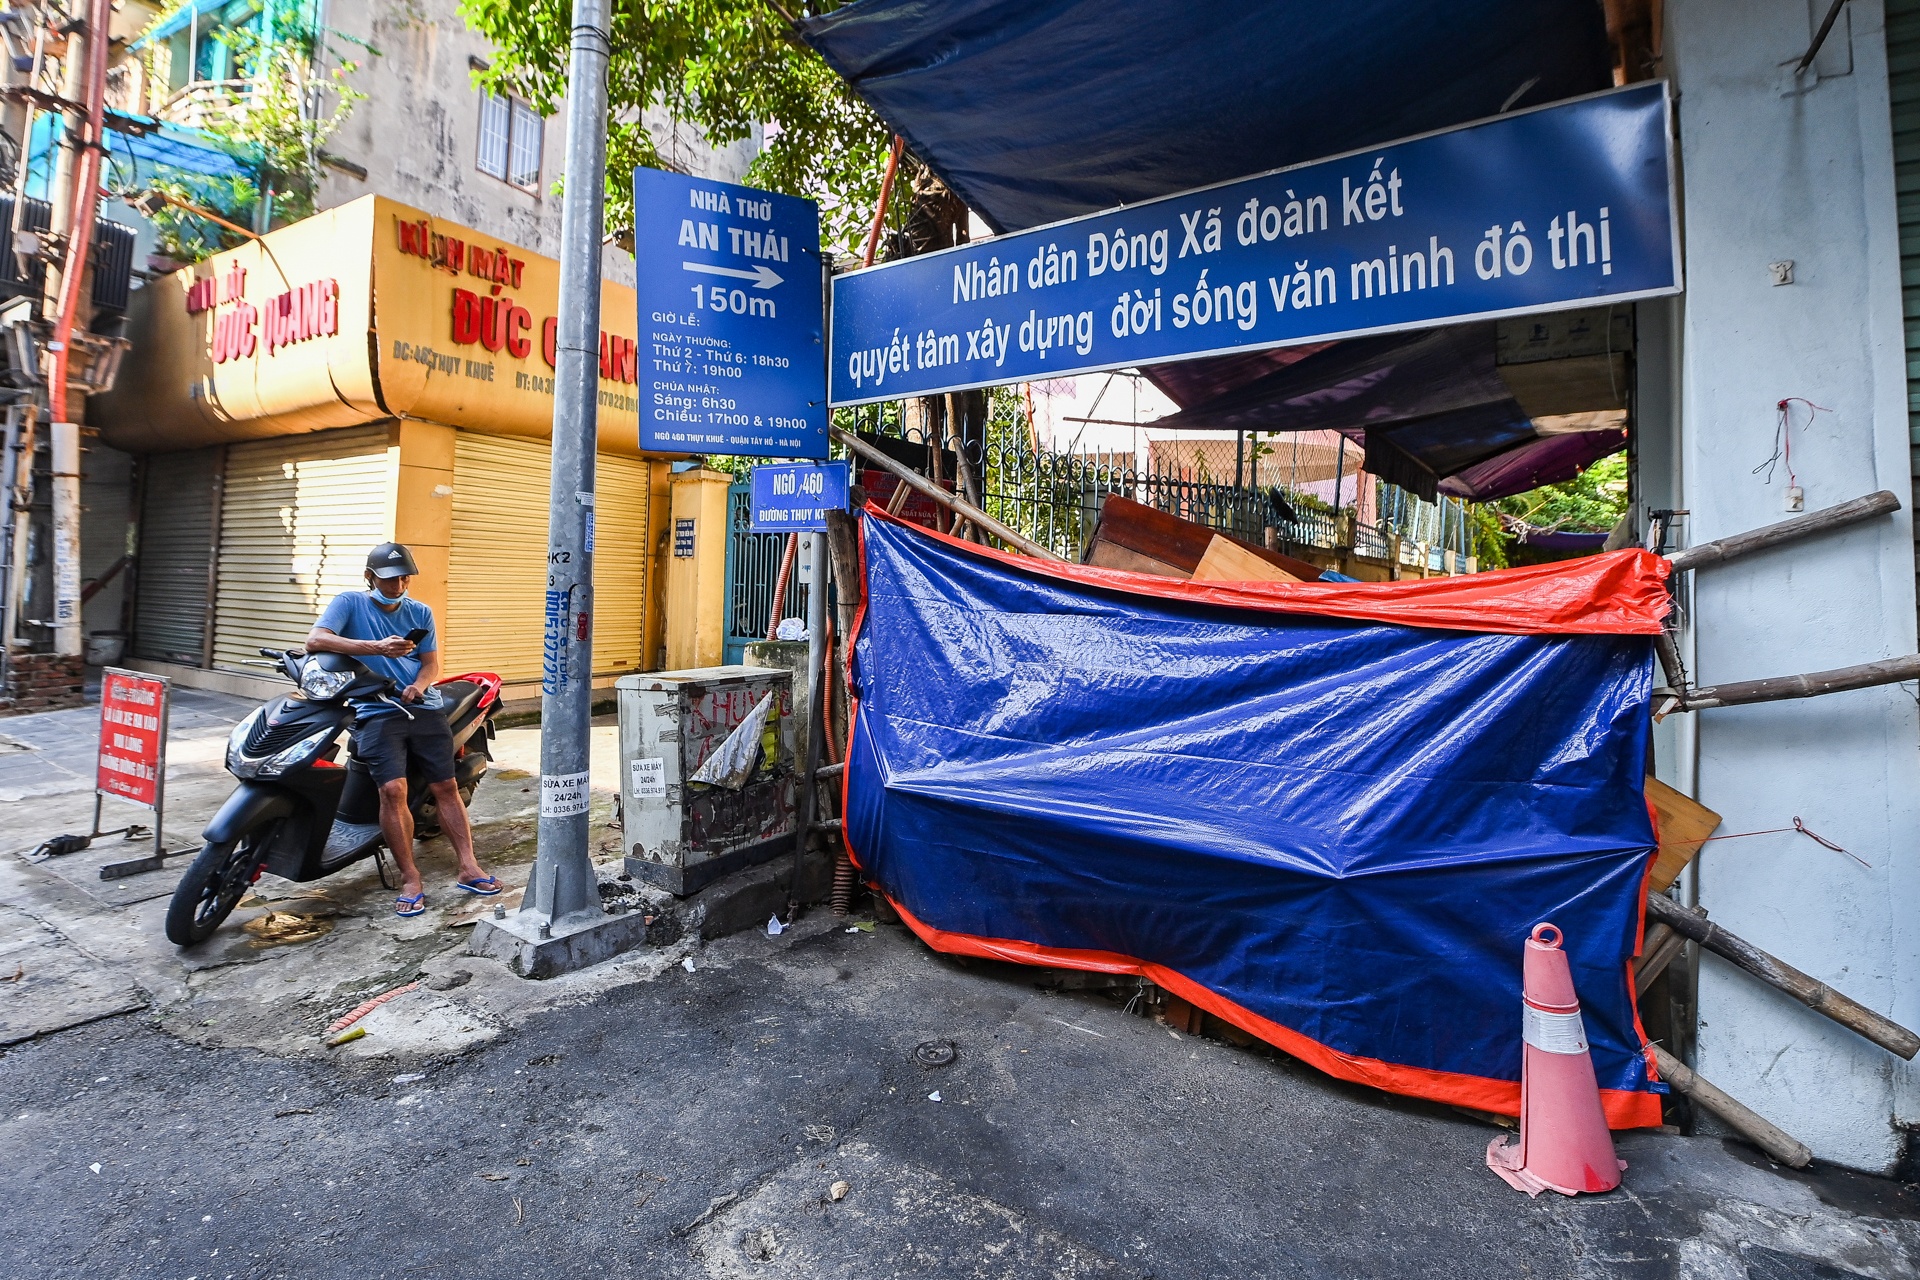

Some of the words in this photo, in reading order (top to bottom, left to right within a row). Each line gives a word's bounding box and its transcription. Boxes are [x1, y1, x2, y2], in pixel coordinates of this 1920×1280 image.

[690, 188, 731, 215] NHÀ
[736, 197, 772, 221] THỜ
[678, 219, 719, 252] AN
[727, 228, 789, 263] THÁI
[952, 257, 1019, 304] Nhân
[1027, 243, 1078, 290] dân
[1087, 227, 1168, 277] Đông
[1179, 207, 1222, 260] Xã
[1237, 189, 1328, 247] đoàn
[1342, 157, 1404, 226] kết
[691, 284, 776, 318] 150m
[849, 327, 909, 388] quyết
[916, 329, 960, 369] tâm
[965, 318, 1011, 367] xây
[1019, 309, 1093, 360] dựng
[1111, 287, 1162, 338] đời
[1172, 268, 1257, 331] sống
[1269, 259, 1337, 313] văn
[1351, 236, 1455, 300] minh
[1475, 220, 1533, 281] đô
[1547, 206, 1612, 276] thị
[452, 285, 532, 359] ĐỨC
[652, 312, 676, 324] GIỜ
[680, 312, 700, 326] LỄ:
[652, 332, 682, 343] NGÀY
[685, 336, 731, 348] THƯỜNG:
[653, 344, 681, 357] Thứ
[684, 347, 692, 358] 2
[706, 349, 732, 362] Thứ
[735, 353, 747, 364] 6:
[752, 354, 789, 368] 18h30
[653, 359, 681, 373] Thứ
[702, 364, 742, 378] 19h00
[653, 381, 684, 392] CHÚA
[688, 384, 720, 395] NHẬT:
[653, 393, 697, 409] Sáng:
[701, 397, 736, 410] 6h30
[654, 407, 702, 423] Chiều:
[707, 412, 749, 426] 17h00
[753, 415, 763, 427] &
[768, 416, 807, 430] 19h00
[671, 432, 685, 441] 460
[686, 433, 704, 444] THỤY
[773, 469, 796, 495] NGÕ
[802, 472, 823, 495] 460
[759, 506, 788, 522] ĐƯỜNG
[791, 508, 813, 524] THỤY
[543, 779, 560, 789] SỬA
[562, 779, 575, 787] XE
[554, 792, 582, 802] 24/24h
